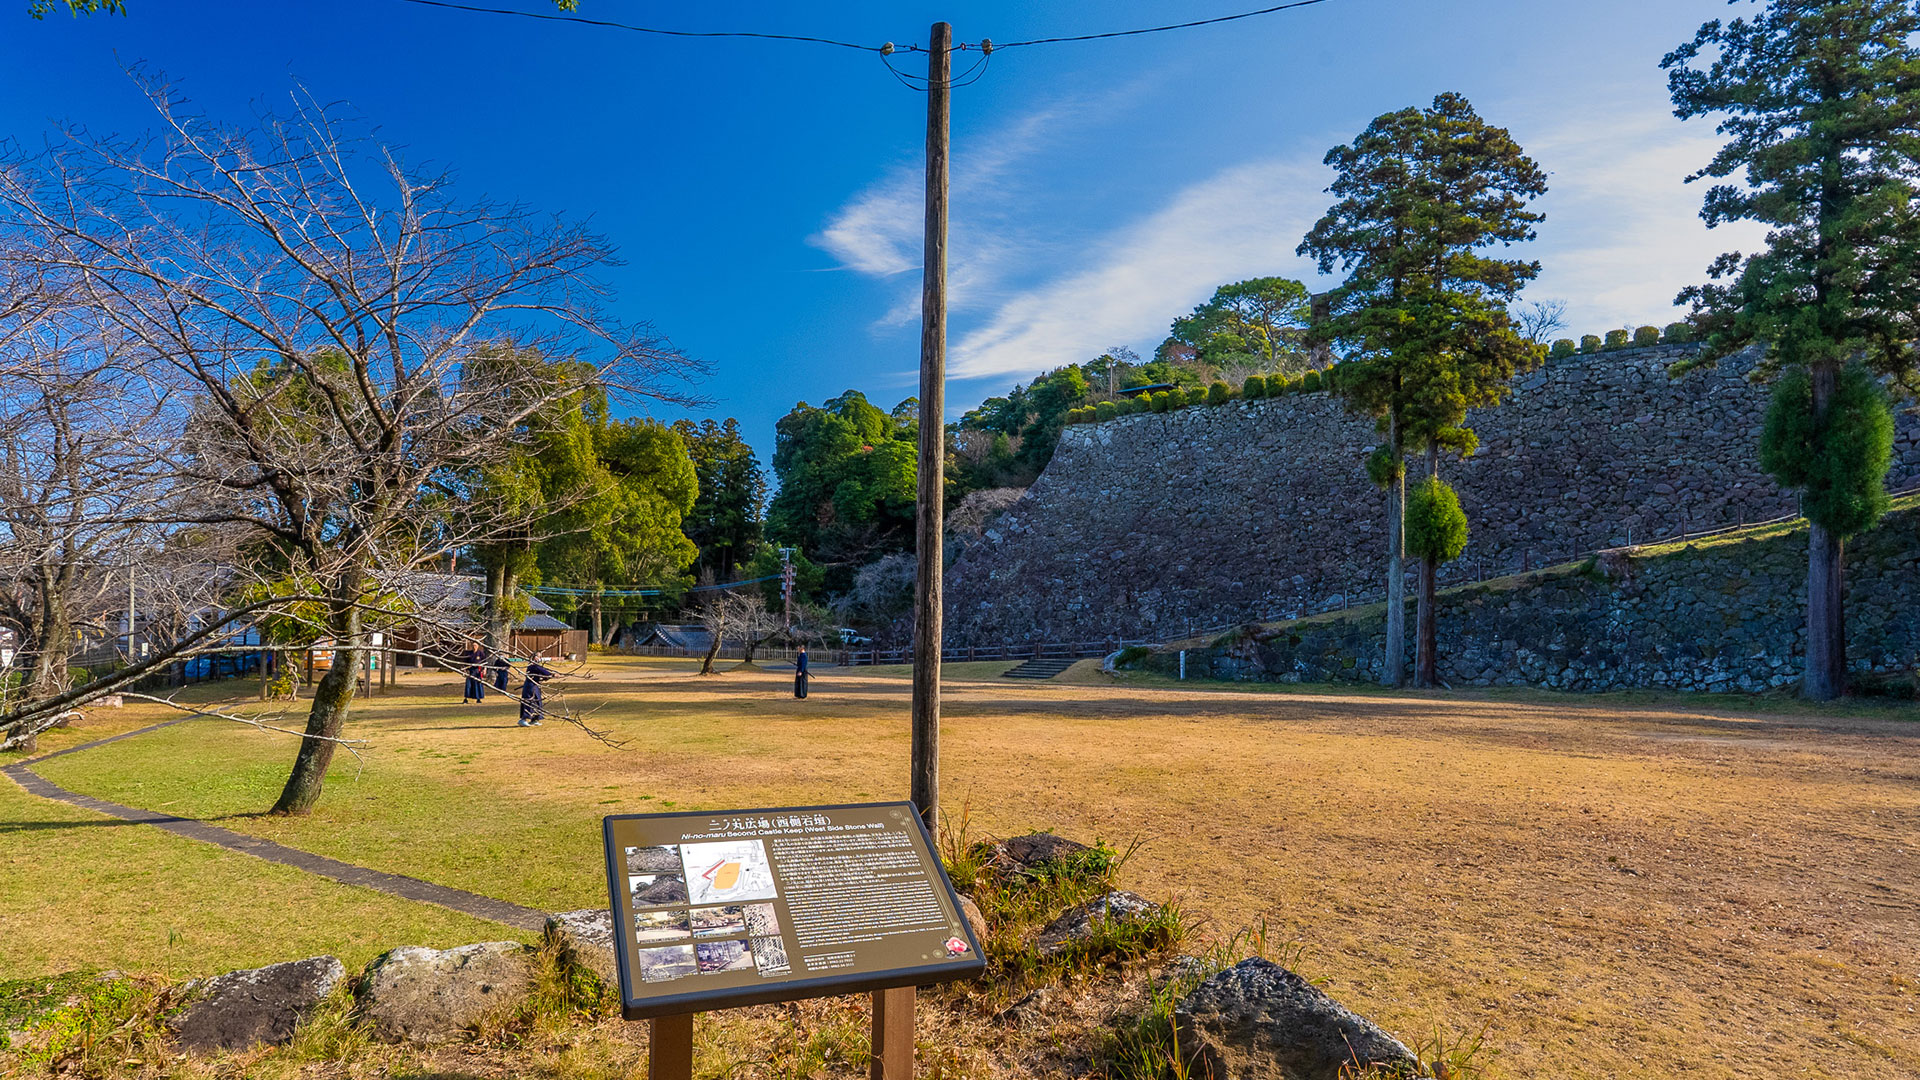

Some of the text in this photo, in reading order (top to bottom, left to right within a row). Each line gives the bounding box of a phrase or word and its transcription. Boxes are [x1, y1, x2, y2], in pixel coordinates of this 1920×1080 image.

[681, 832, 726, 840] Ni-no-maru
[726, 830, 757, 838] Second
[758, 828, 782, 836] Castle
[783, 826, 803, 835] Keep
[804, 826, 826, 834] (West
[866, 822, 885, 830] Wall)
